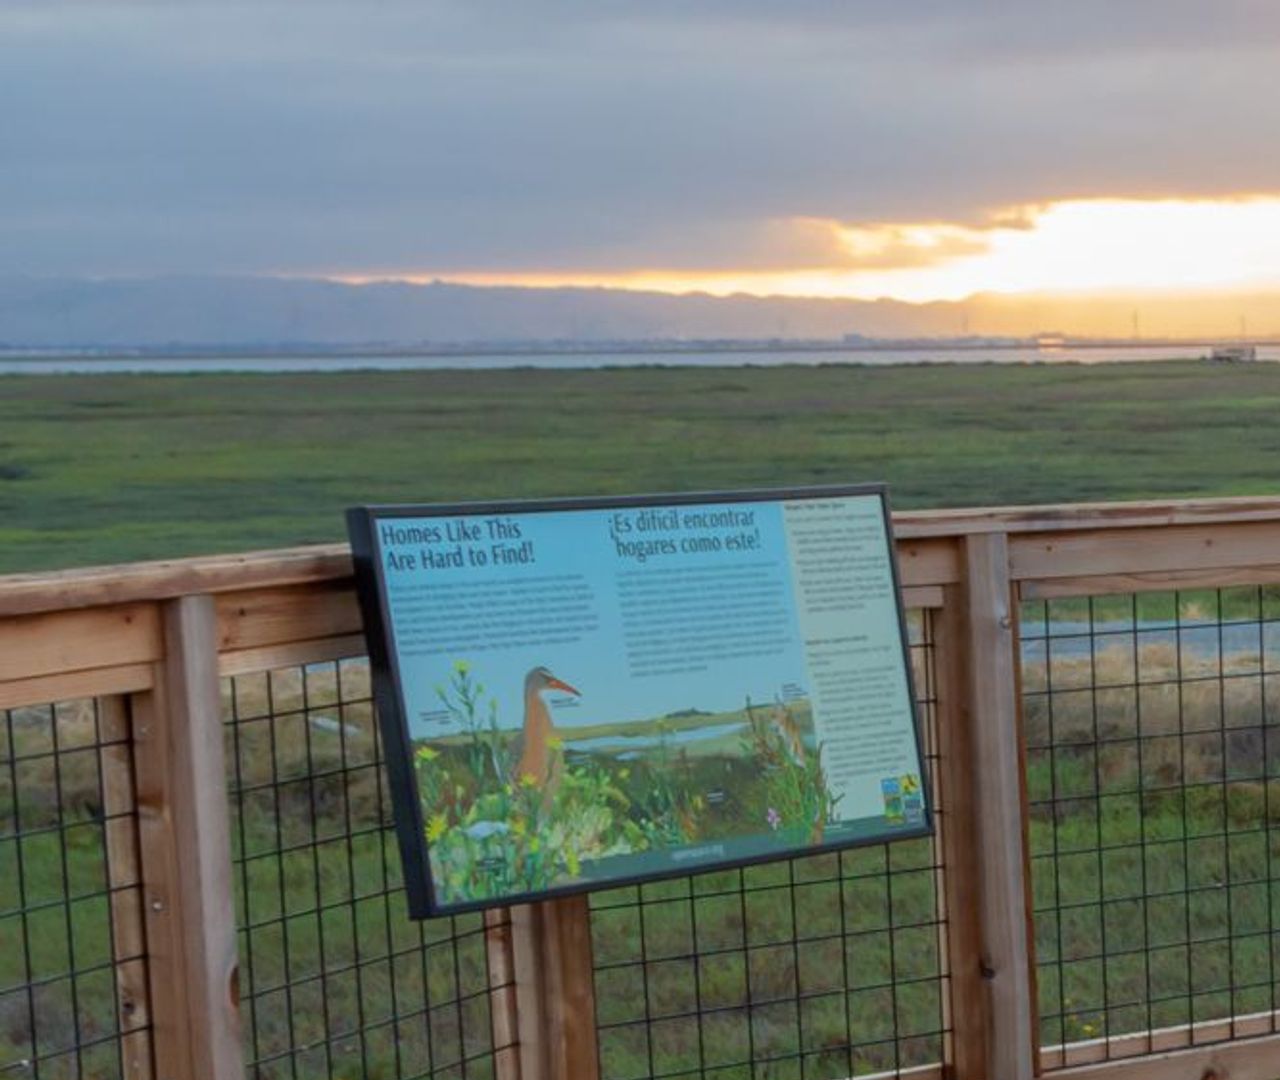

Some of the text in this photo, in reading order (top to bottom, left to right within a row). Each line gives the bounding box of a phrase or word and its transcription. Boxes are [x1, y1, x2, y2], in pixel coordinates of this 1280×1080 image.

[381, 517, 521, 545] Homes Like This
[684, 510, 754, 529] encontrar
[387, 540, 536, 570] Are Hard to Find!
[616, 528, 760, 563] hogares como este!
